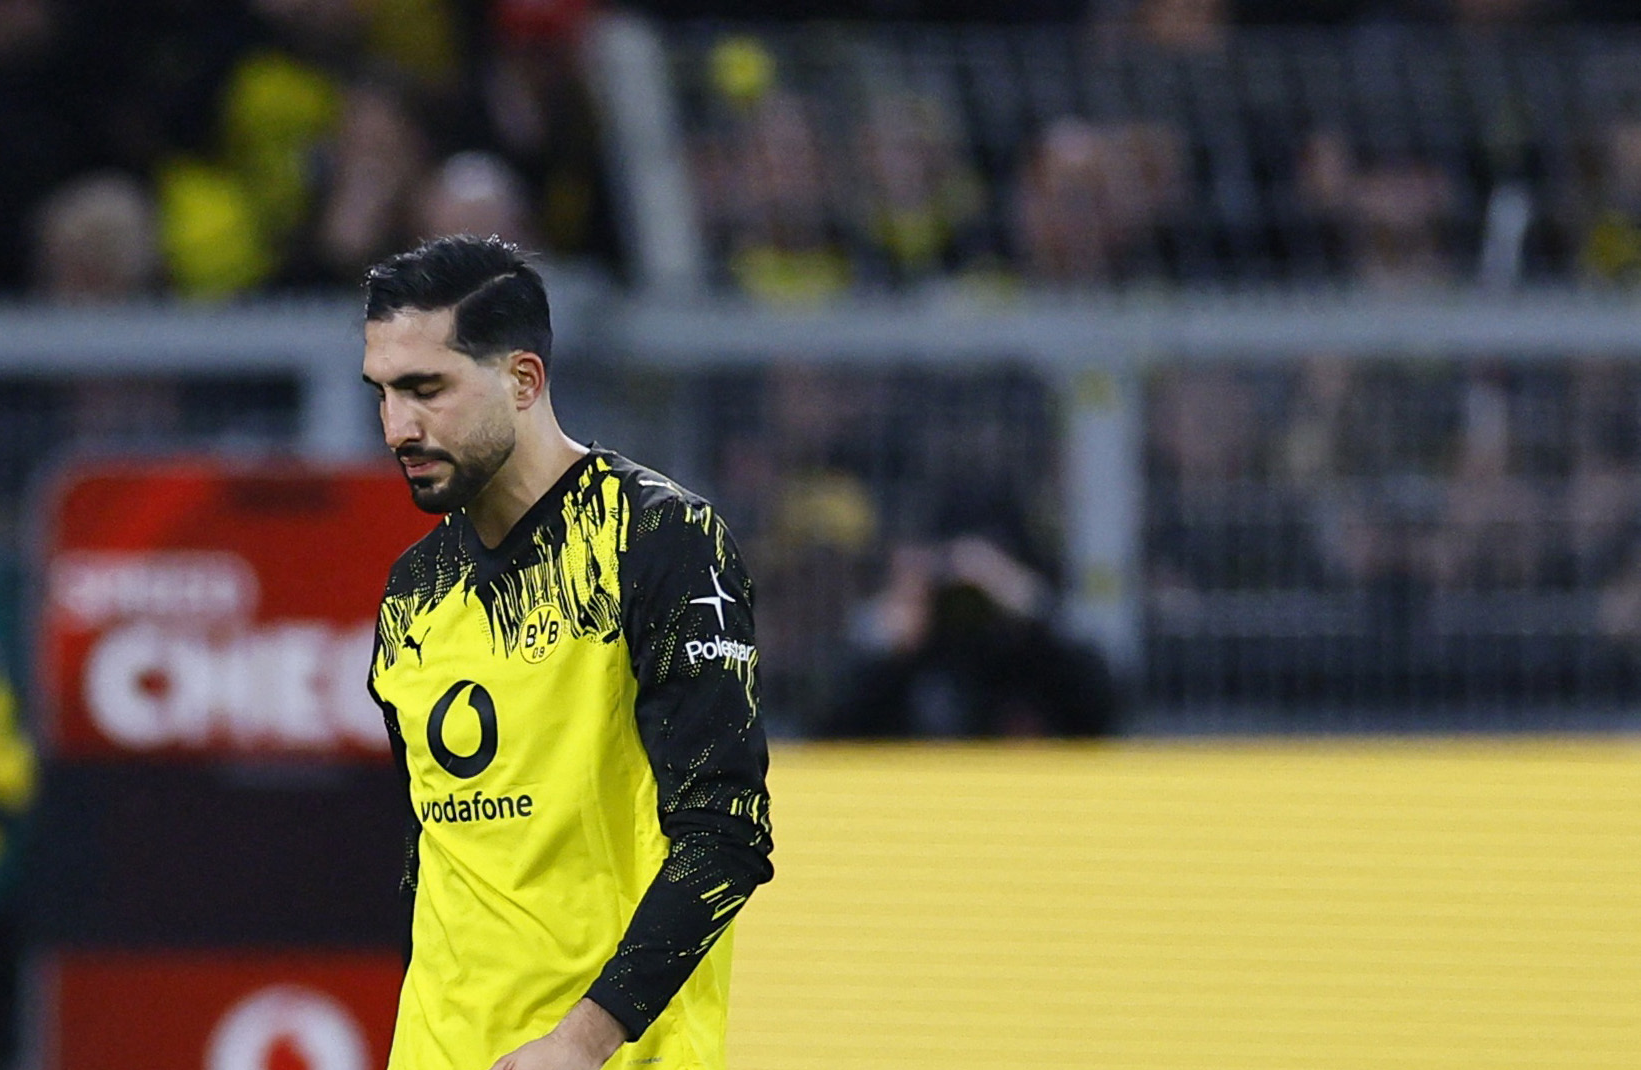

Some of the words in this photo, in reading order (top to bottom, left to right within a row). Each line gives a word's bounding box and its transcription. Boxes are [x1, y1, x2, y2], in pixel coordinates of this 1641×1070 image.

[525, 610, 559, 648] BVB
[532, 646, 545, 659] 09
[685, 635, 755, 664] Polestar
[421, 791, 533, 823] vodafone
